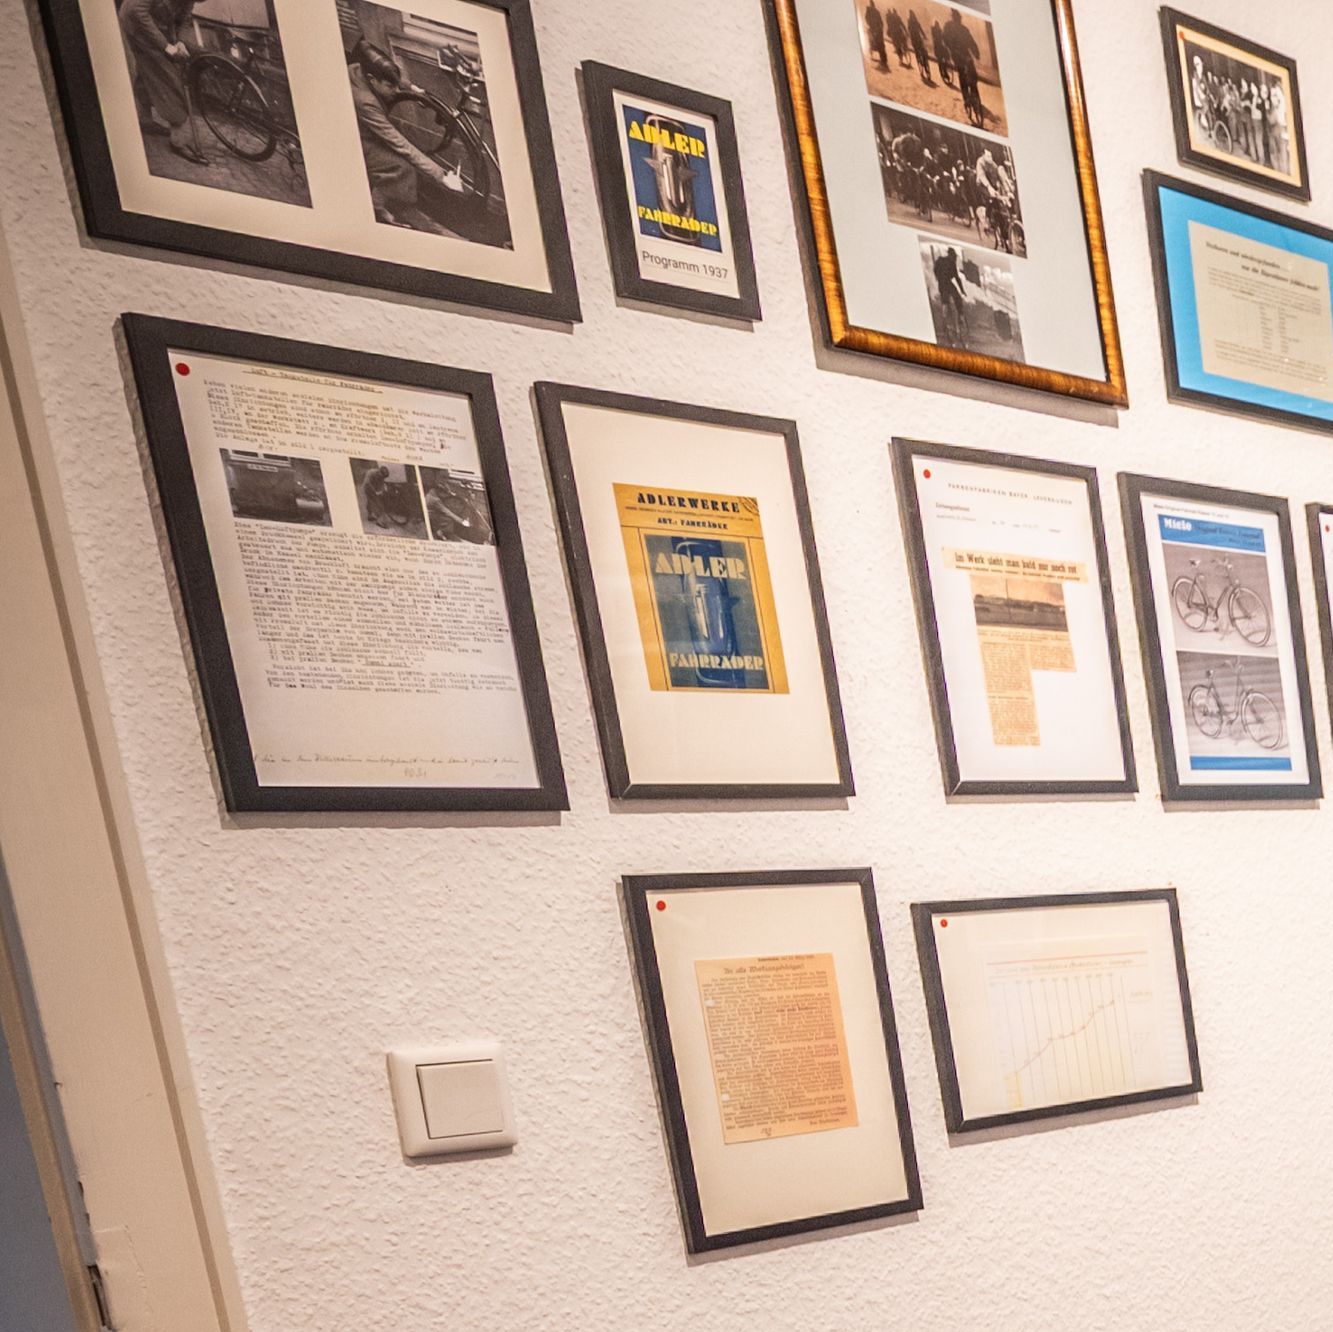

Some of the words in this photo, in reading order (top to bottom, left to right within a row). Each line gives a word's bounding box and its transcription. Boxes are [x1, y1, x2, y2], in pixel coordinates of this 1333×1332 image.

[628, 121, 706, 159] ADLER
[642, 250, 700, 274] Programm
[702, 263, 728, 280] 1937
[637, 492, 740, 513] ADLERWERKE
[1163, 517, 1193, 532] Miele
[655, 553, 748, 580] ADLER
[967, 553, 985, 564] Werk
